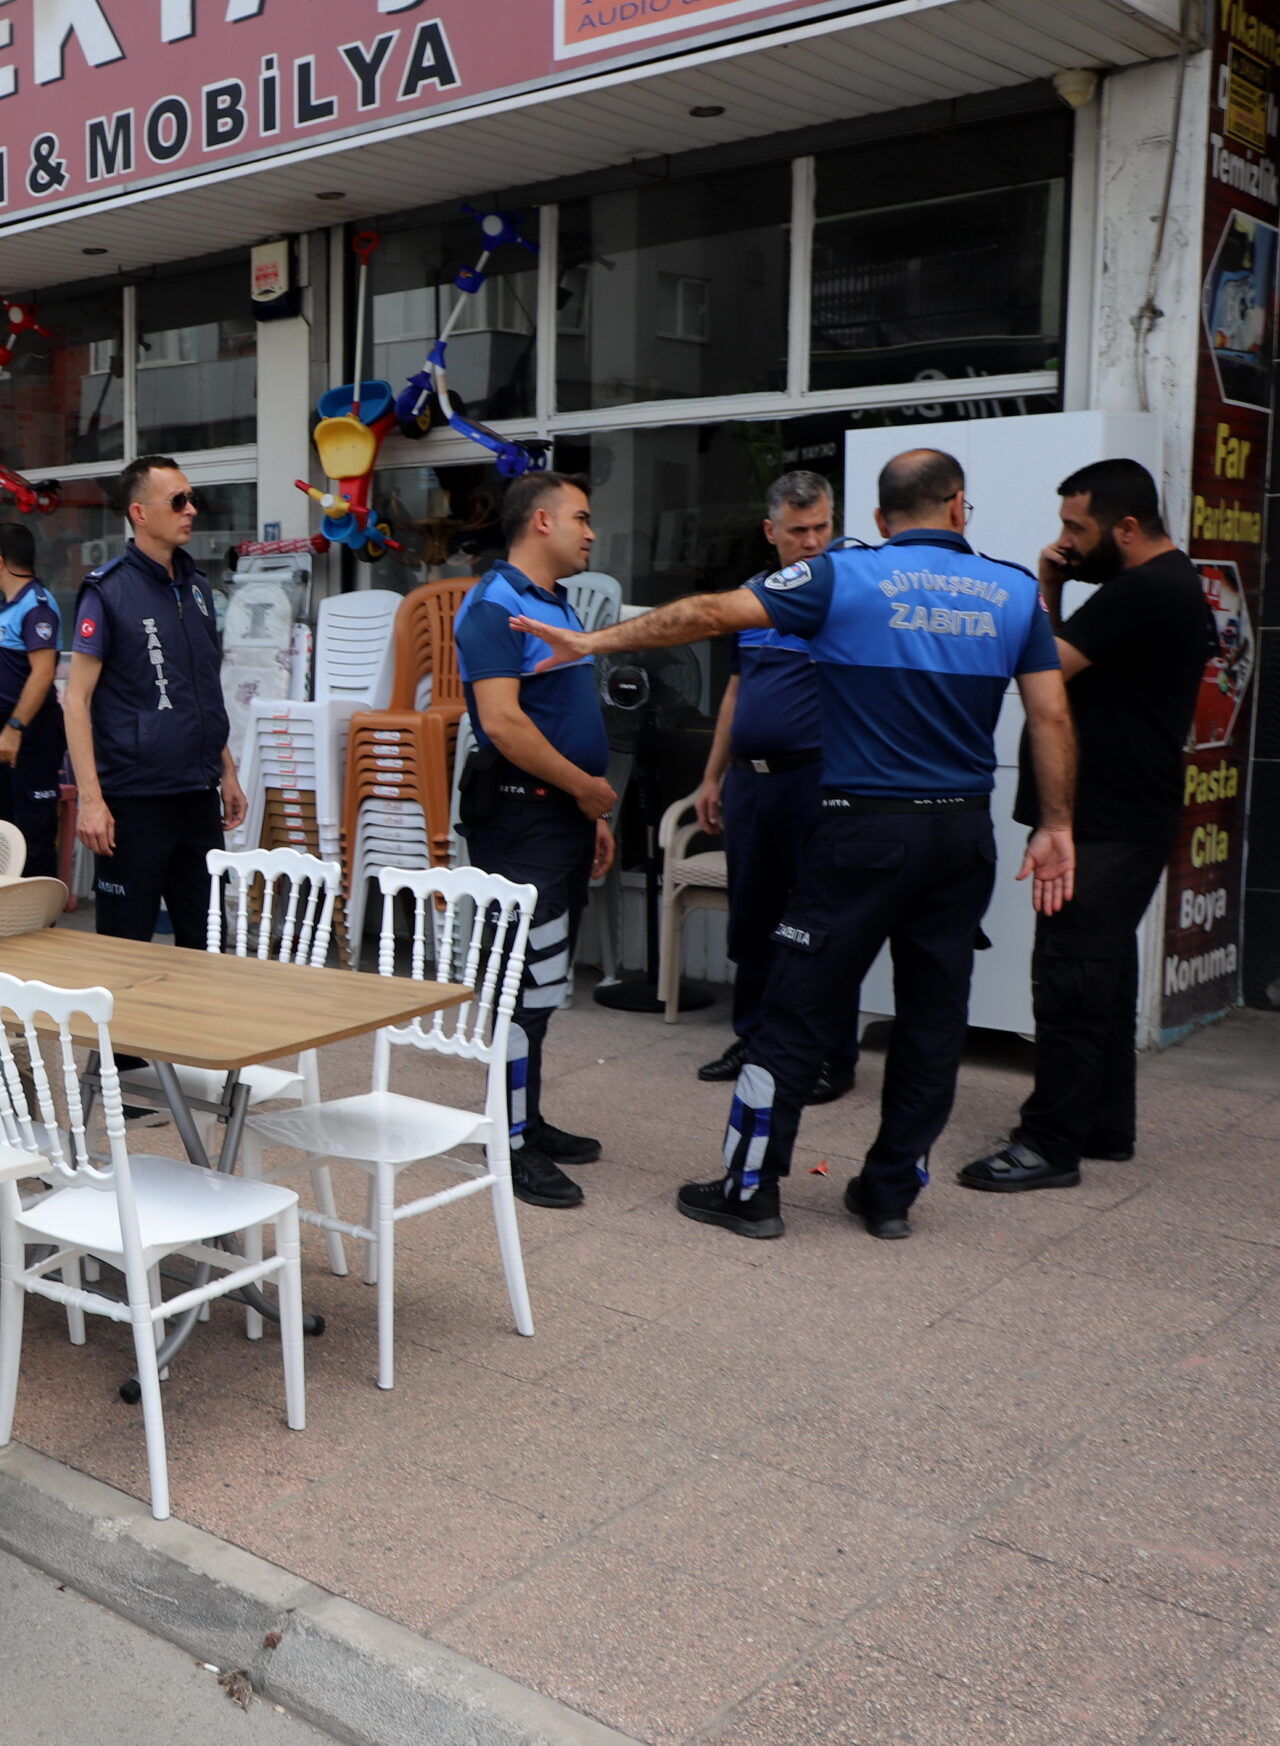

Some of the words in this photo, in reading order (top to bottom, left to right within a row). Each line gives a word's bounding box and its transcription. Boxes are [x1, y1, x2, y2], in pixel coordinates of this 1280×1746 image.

[577, 0, 671, 32] AUDIO
[26, 132, 69, 196] &
[86, 18, 462, 183] MOBİLYA
[1210, 132, 1279, 206] Temizlik
[1214, 422, 1251, 480] Far
[1192, 495, 1262, 544] Parlatma
[878, 568, 1010, 607] BÜYÜKŞEHİR
[888, 602, 998, 638] ZABITA
[142, 617, 173, 711] ZABITA
[1183, 759, 1238, 807] Pasta
[1190, 823, 1229, 869] Cila
[1179, 887, 1227, 932] Boya
[774, 922, 811, 947] ZABITA
[1164, 942, 1238, 997] Koruma
